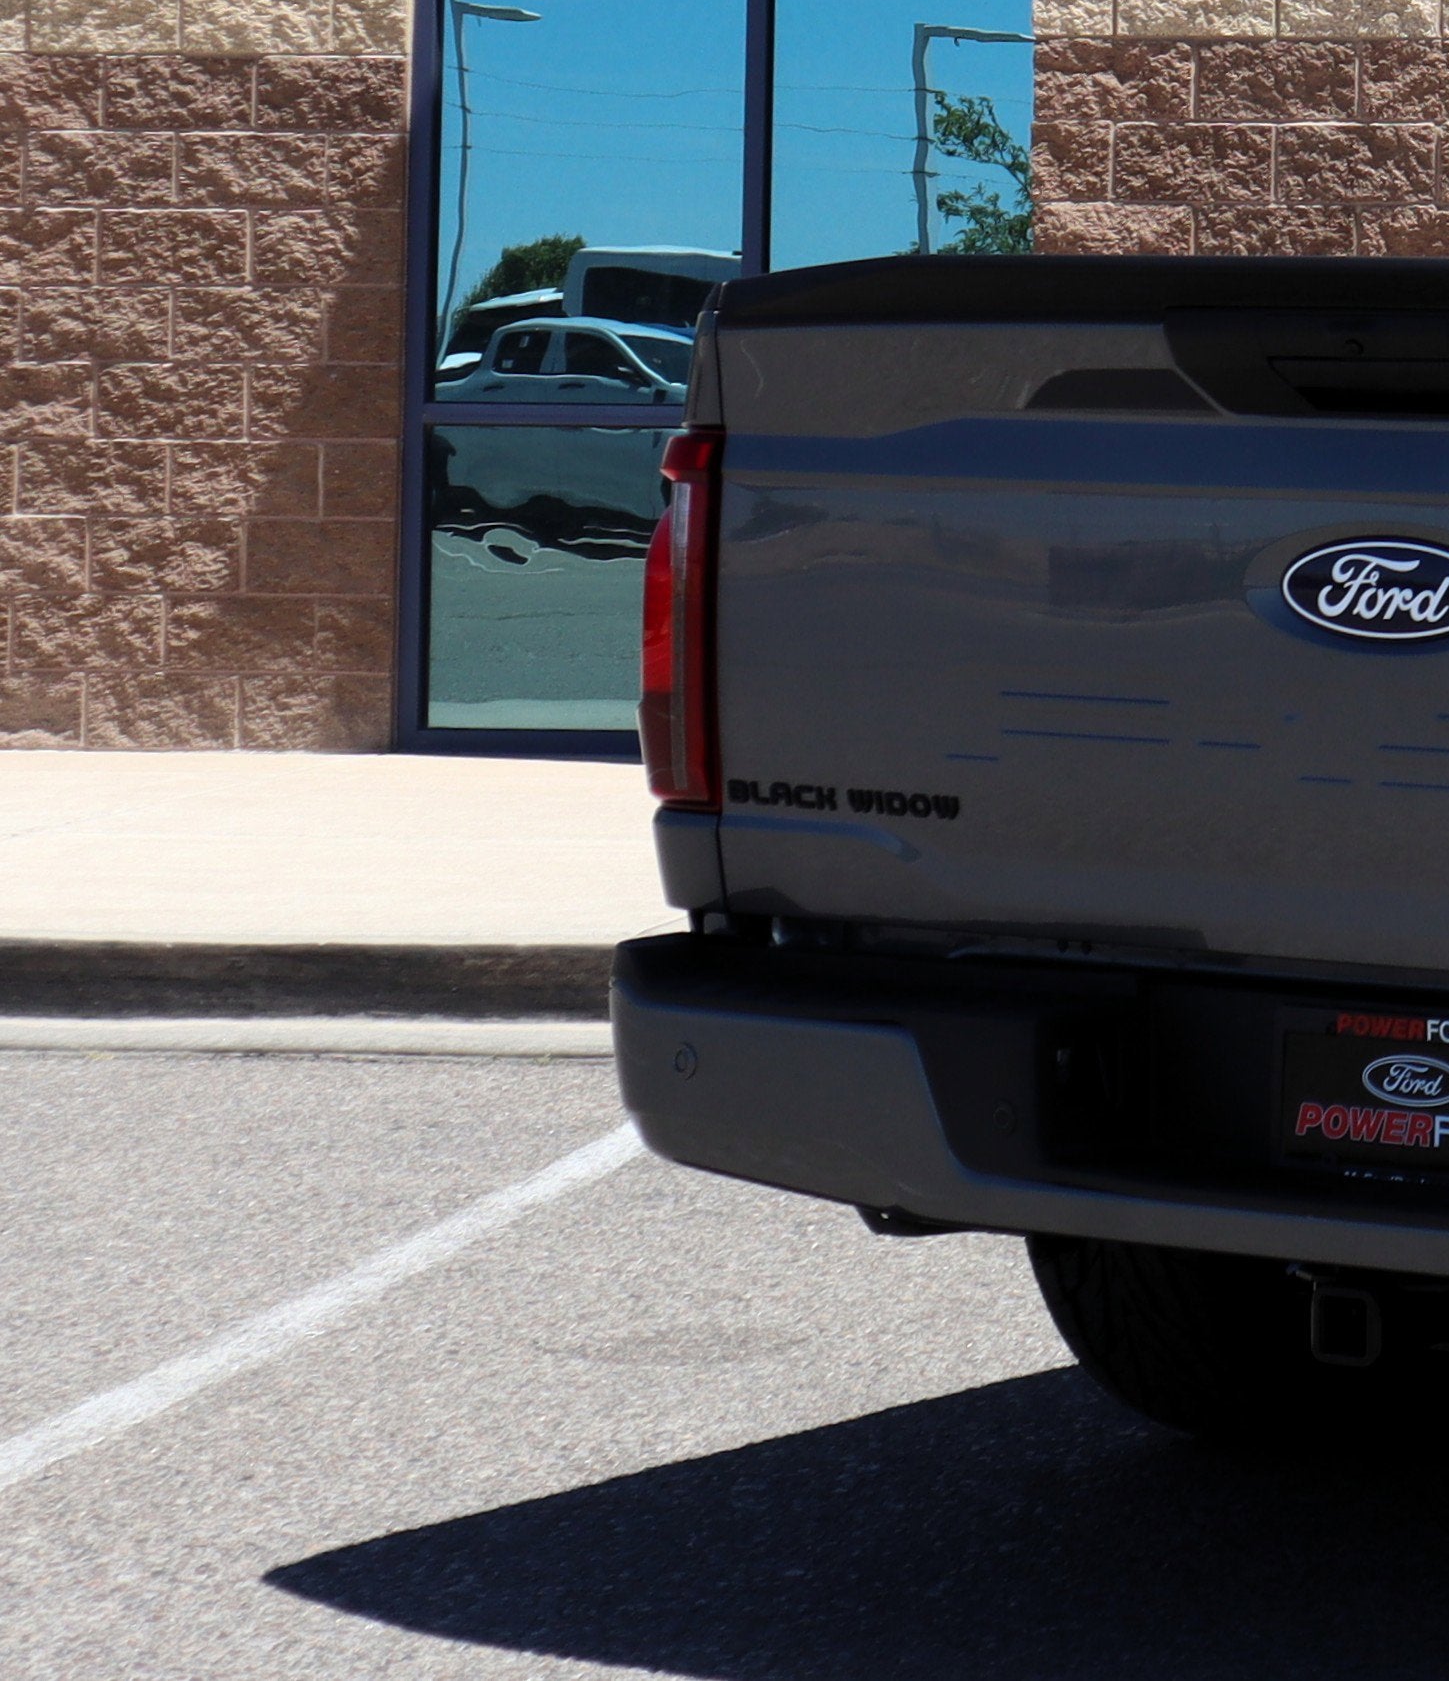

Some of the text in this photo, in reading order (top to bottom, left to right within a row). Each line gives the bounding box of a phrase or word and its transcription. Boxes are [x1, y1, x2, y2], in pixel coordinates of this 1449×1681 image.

[727, 779, 961, 820] BLACK WIDOW
[1382, 1062, 1444, 1097] Ford
